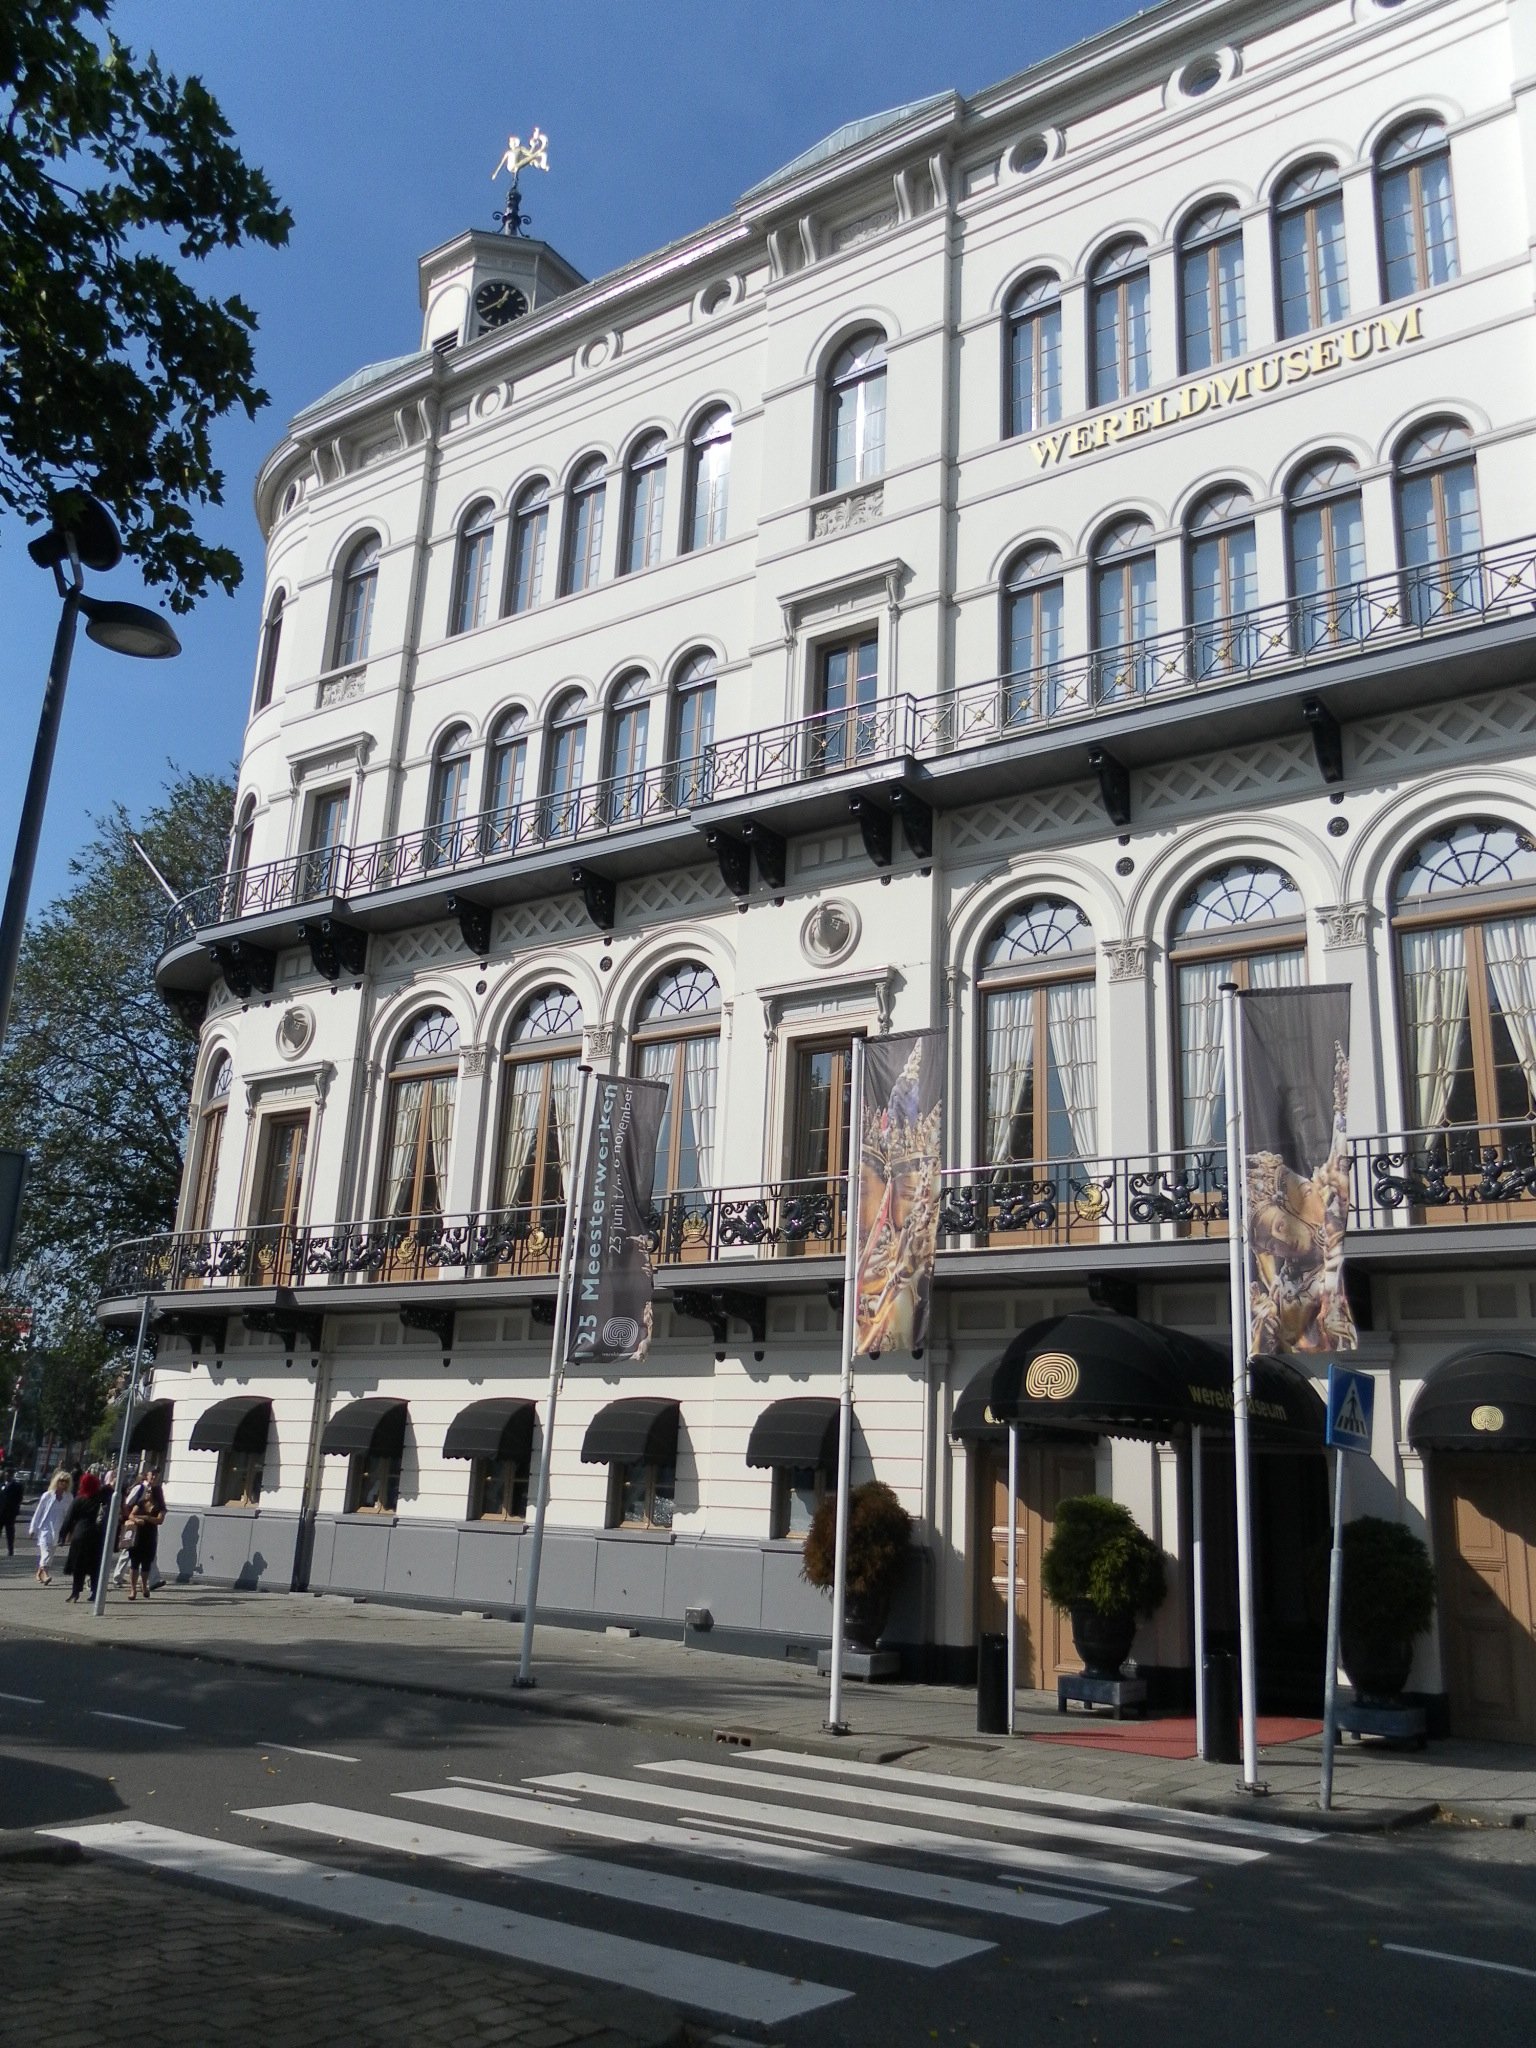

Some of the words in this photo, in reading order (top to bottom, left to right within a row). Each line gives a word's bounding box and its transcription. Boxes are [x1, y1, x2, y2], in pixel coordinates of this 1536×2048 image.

[1029, 307, 1424, 469] WERELDMUSEUM
[614, 1087, 633, 1153] november
[581, 1084, 618, 1300] Meesterwerken
[611, 1204, 627, 1231] juni
[608, 1236, 622, 1254] 23
[574, 1315, 597, 1358] 125
